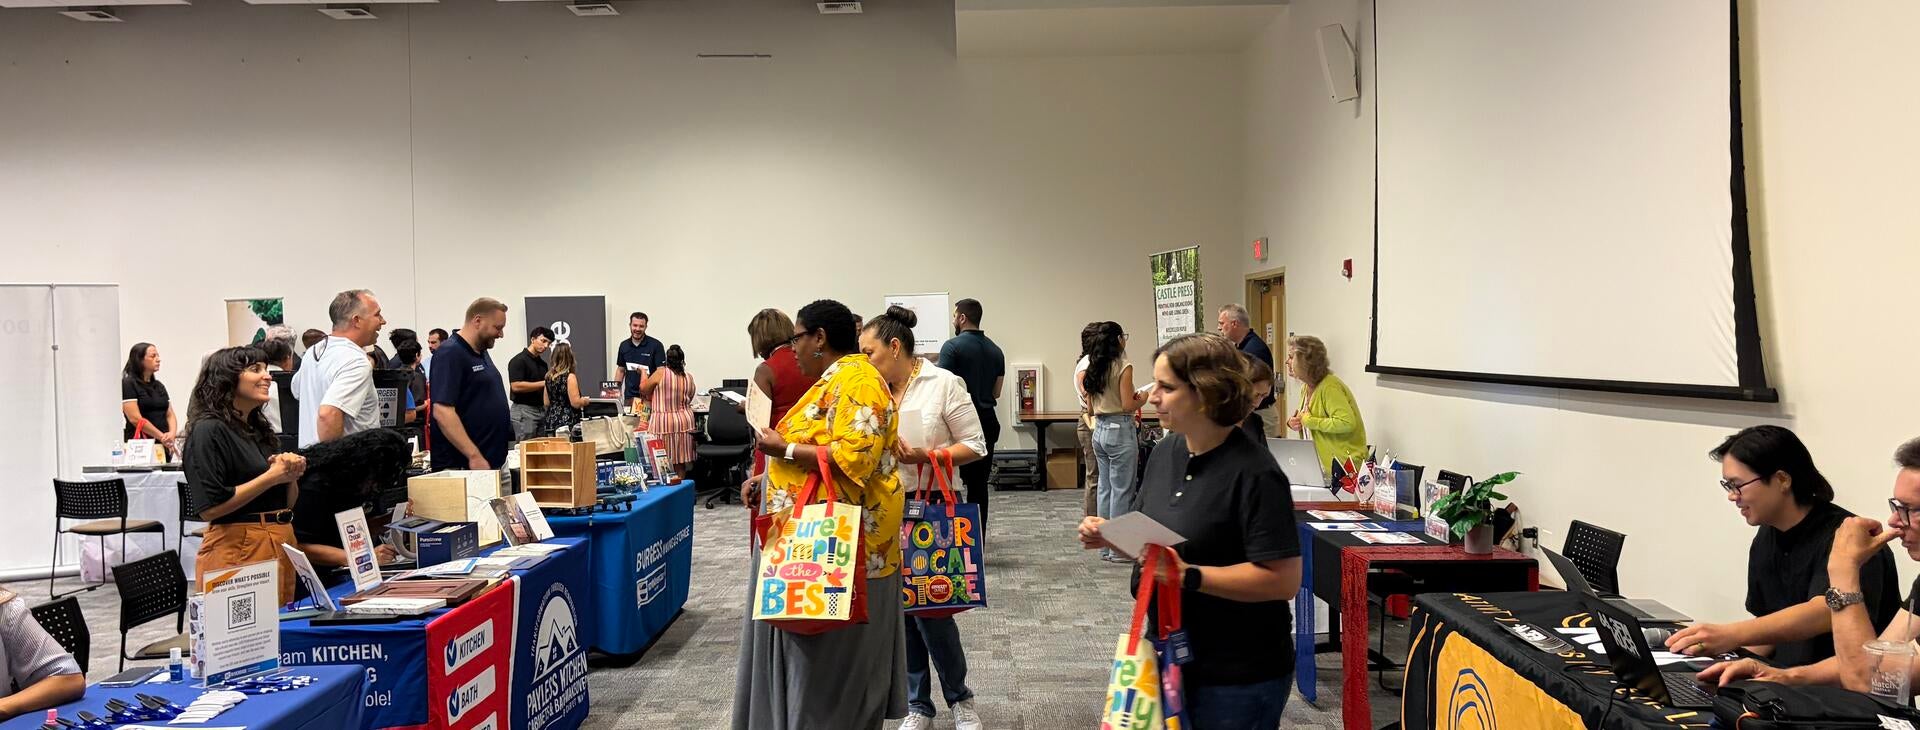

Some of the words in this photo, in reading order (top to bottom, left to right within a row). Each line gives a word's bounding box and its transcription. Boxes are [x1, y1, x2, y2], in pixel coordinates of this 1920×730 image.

[1157, 286, 1176, 300] CASTLE
[1177, 284, 1193, 298] PRESS
[899, 516, 976, 549] YOUR
[636, 539, 663, 573] BURGESS
[770, 536, 851, 567] Simply
[900, 547, 978, 576] LOCAL
[782, 563, 817, 577] the
[760, 578, 848, 617] BEST
[902, 574, 981, 608] STORE
[312, 643, 389, 663] KITCHEN,
[459, 629, 486, 660] KITCHEN
[461, 683, 479, 709] BATH
[527, 673, 559, 719] PAYLESS
[560, 650, 588, 692] KITCHEN
